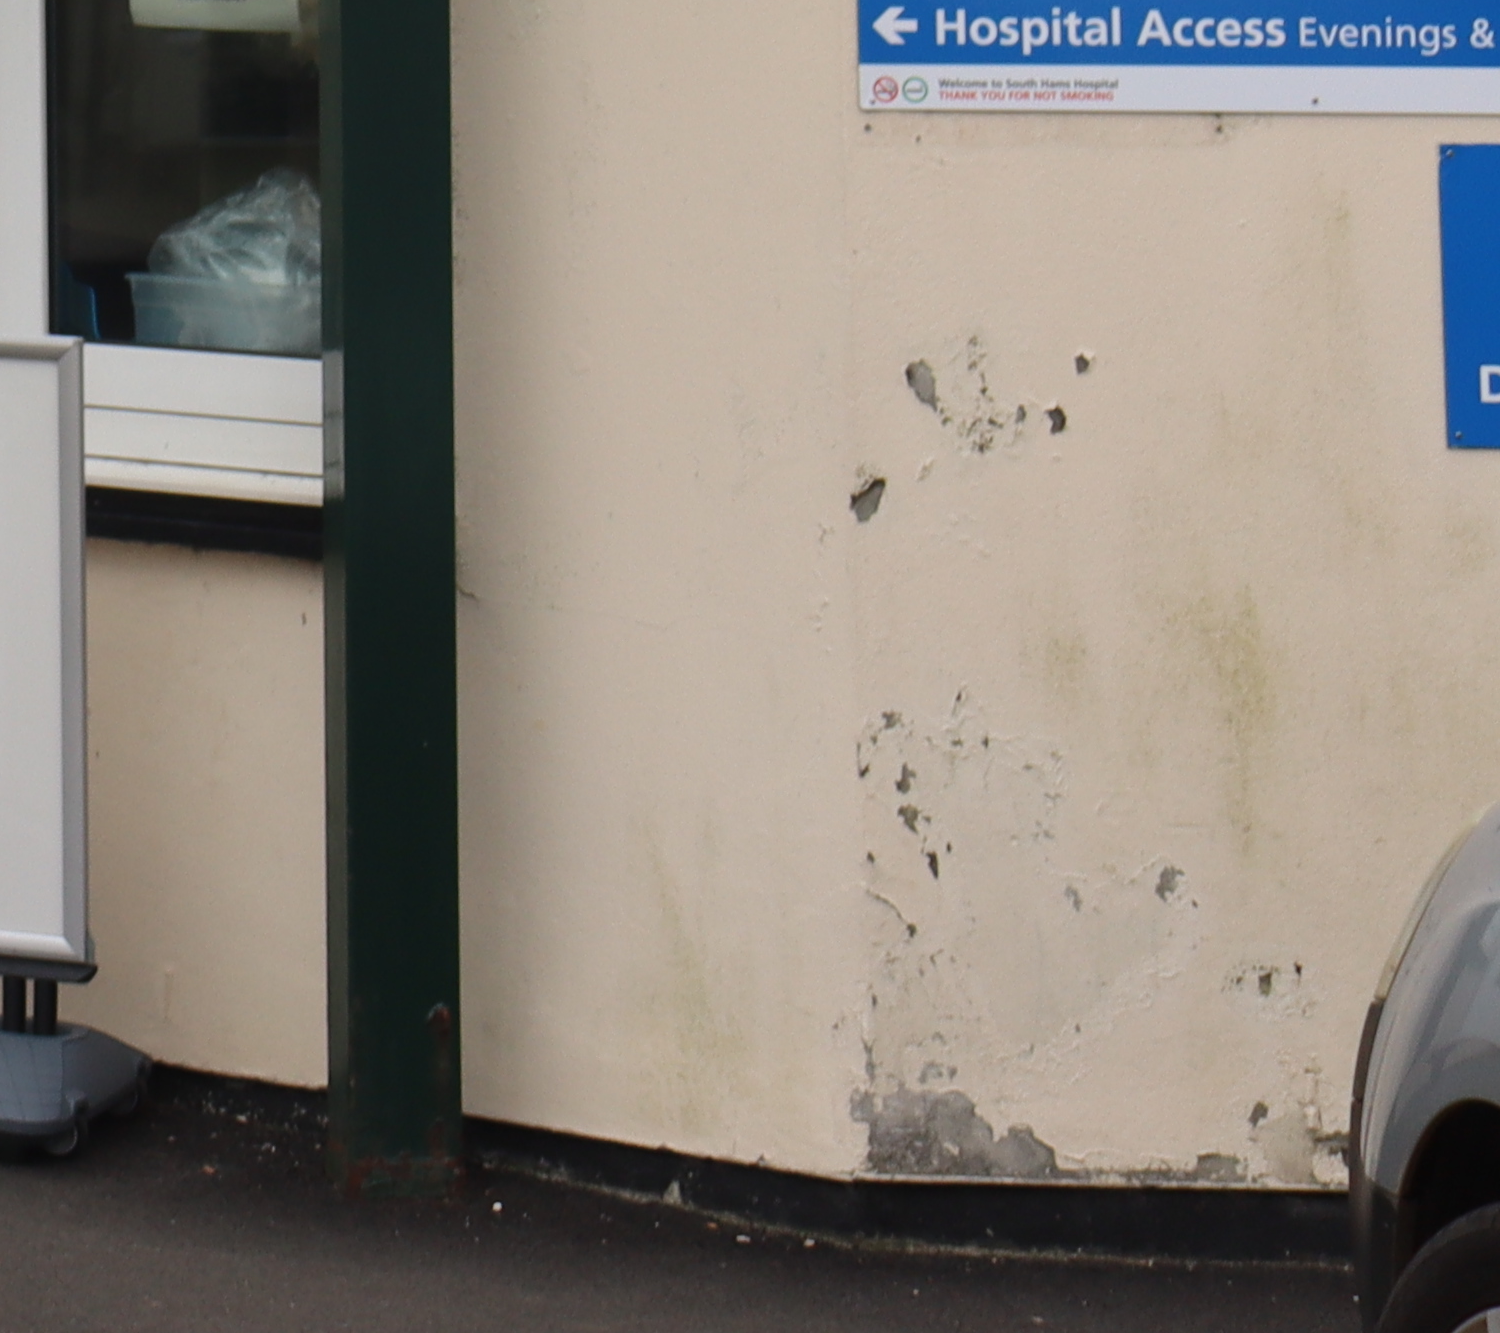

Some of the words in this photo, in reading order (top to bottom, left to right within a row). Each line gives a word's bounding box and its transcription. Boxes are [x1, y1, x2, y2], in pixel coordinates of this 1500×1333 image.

[935, 8, 1122, 55] Hospital
[1137, 10, 1286, 48] Access
[1301, 16, 1457, 56] Evenings
[1469, 17, 1495, 49] &
[938, 78, 988, 89] Welcome
[991, 78, 1003, 89] to
[1006, 78, 1038, 89] South
[1041, 78, 1071, 89] Hams
[1074, 78, 1119, 91] Hospital
[938, 89, 977, 101] THANK
[981, 89, 1006, 101] YOU
[1010, 89, 1030, 101] FOR
[1033, 89, 1057, 101] NOT
[1060, 89, 1115, 101] SMOKING
